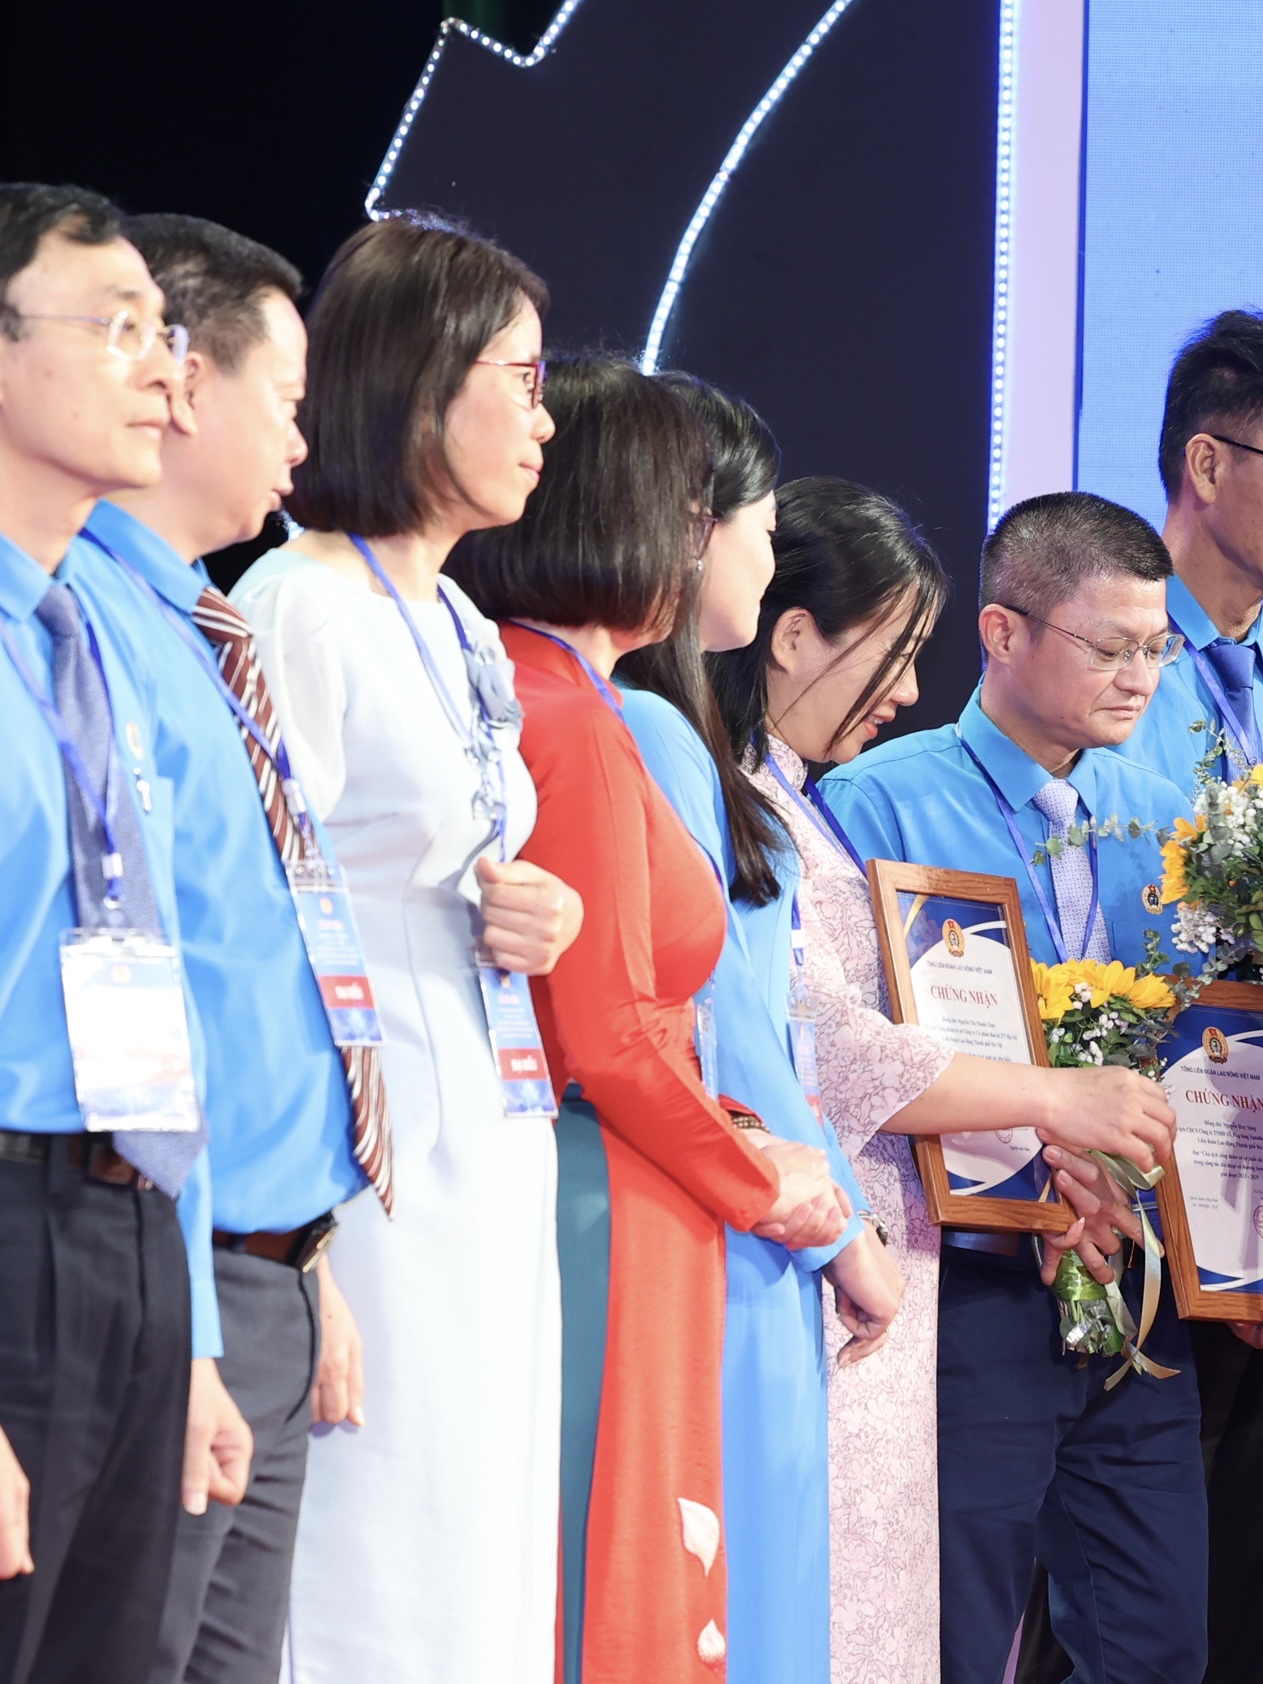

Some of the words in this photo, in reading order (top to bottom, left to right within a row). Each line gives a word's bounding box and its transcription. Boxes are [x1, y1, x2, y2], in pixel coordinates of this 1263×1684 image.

[930, 984, 967, 1003] CHỨNG
[969, 990, 998, 1008] NHẬN
[1180, 1065, 1193, 1073] TỔNG
[1227, 1070, 1239, 1078] ĐỘNG
[1239, 1072, 1249, 1080] VIỆT
[1185, 1088, 1229, 1107] CHỨNG
